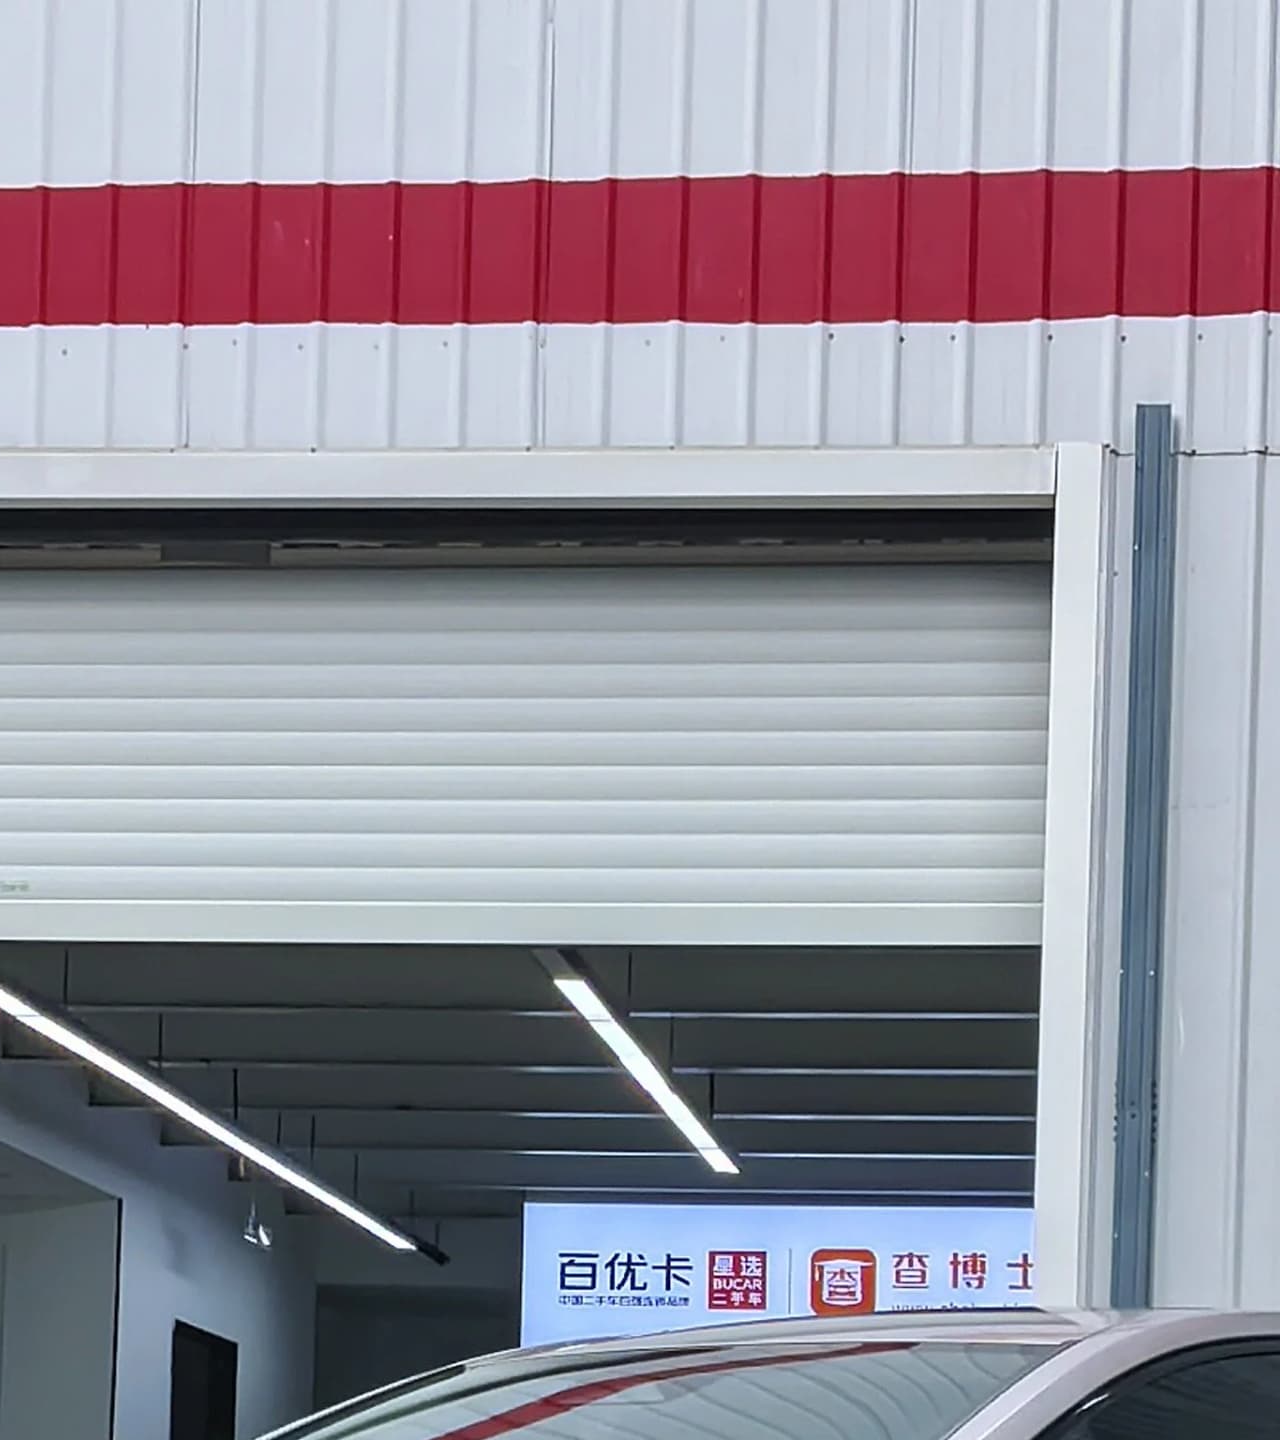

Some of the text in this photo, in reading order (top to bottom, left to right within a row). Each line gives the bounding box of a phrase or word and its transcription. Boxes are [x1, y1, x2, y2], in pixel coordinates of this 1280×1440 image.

[558, 1252, 694, 1290] 百优卡
[712, 1255, 763, 1277] 星选
[712, 1278, 763, 1291] BUCAR
[712, 1292, 763, 1308] 二手车
